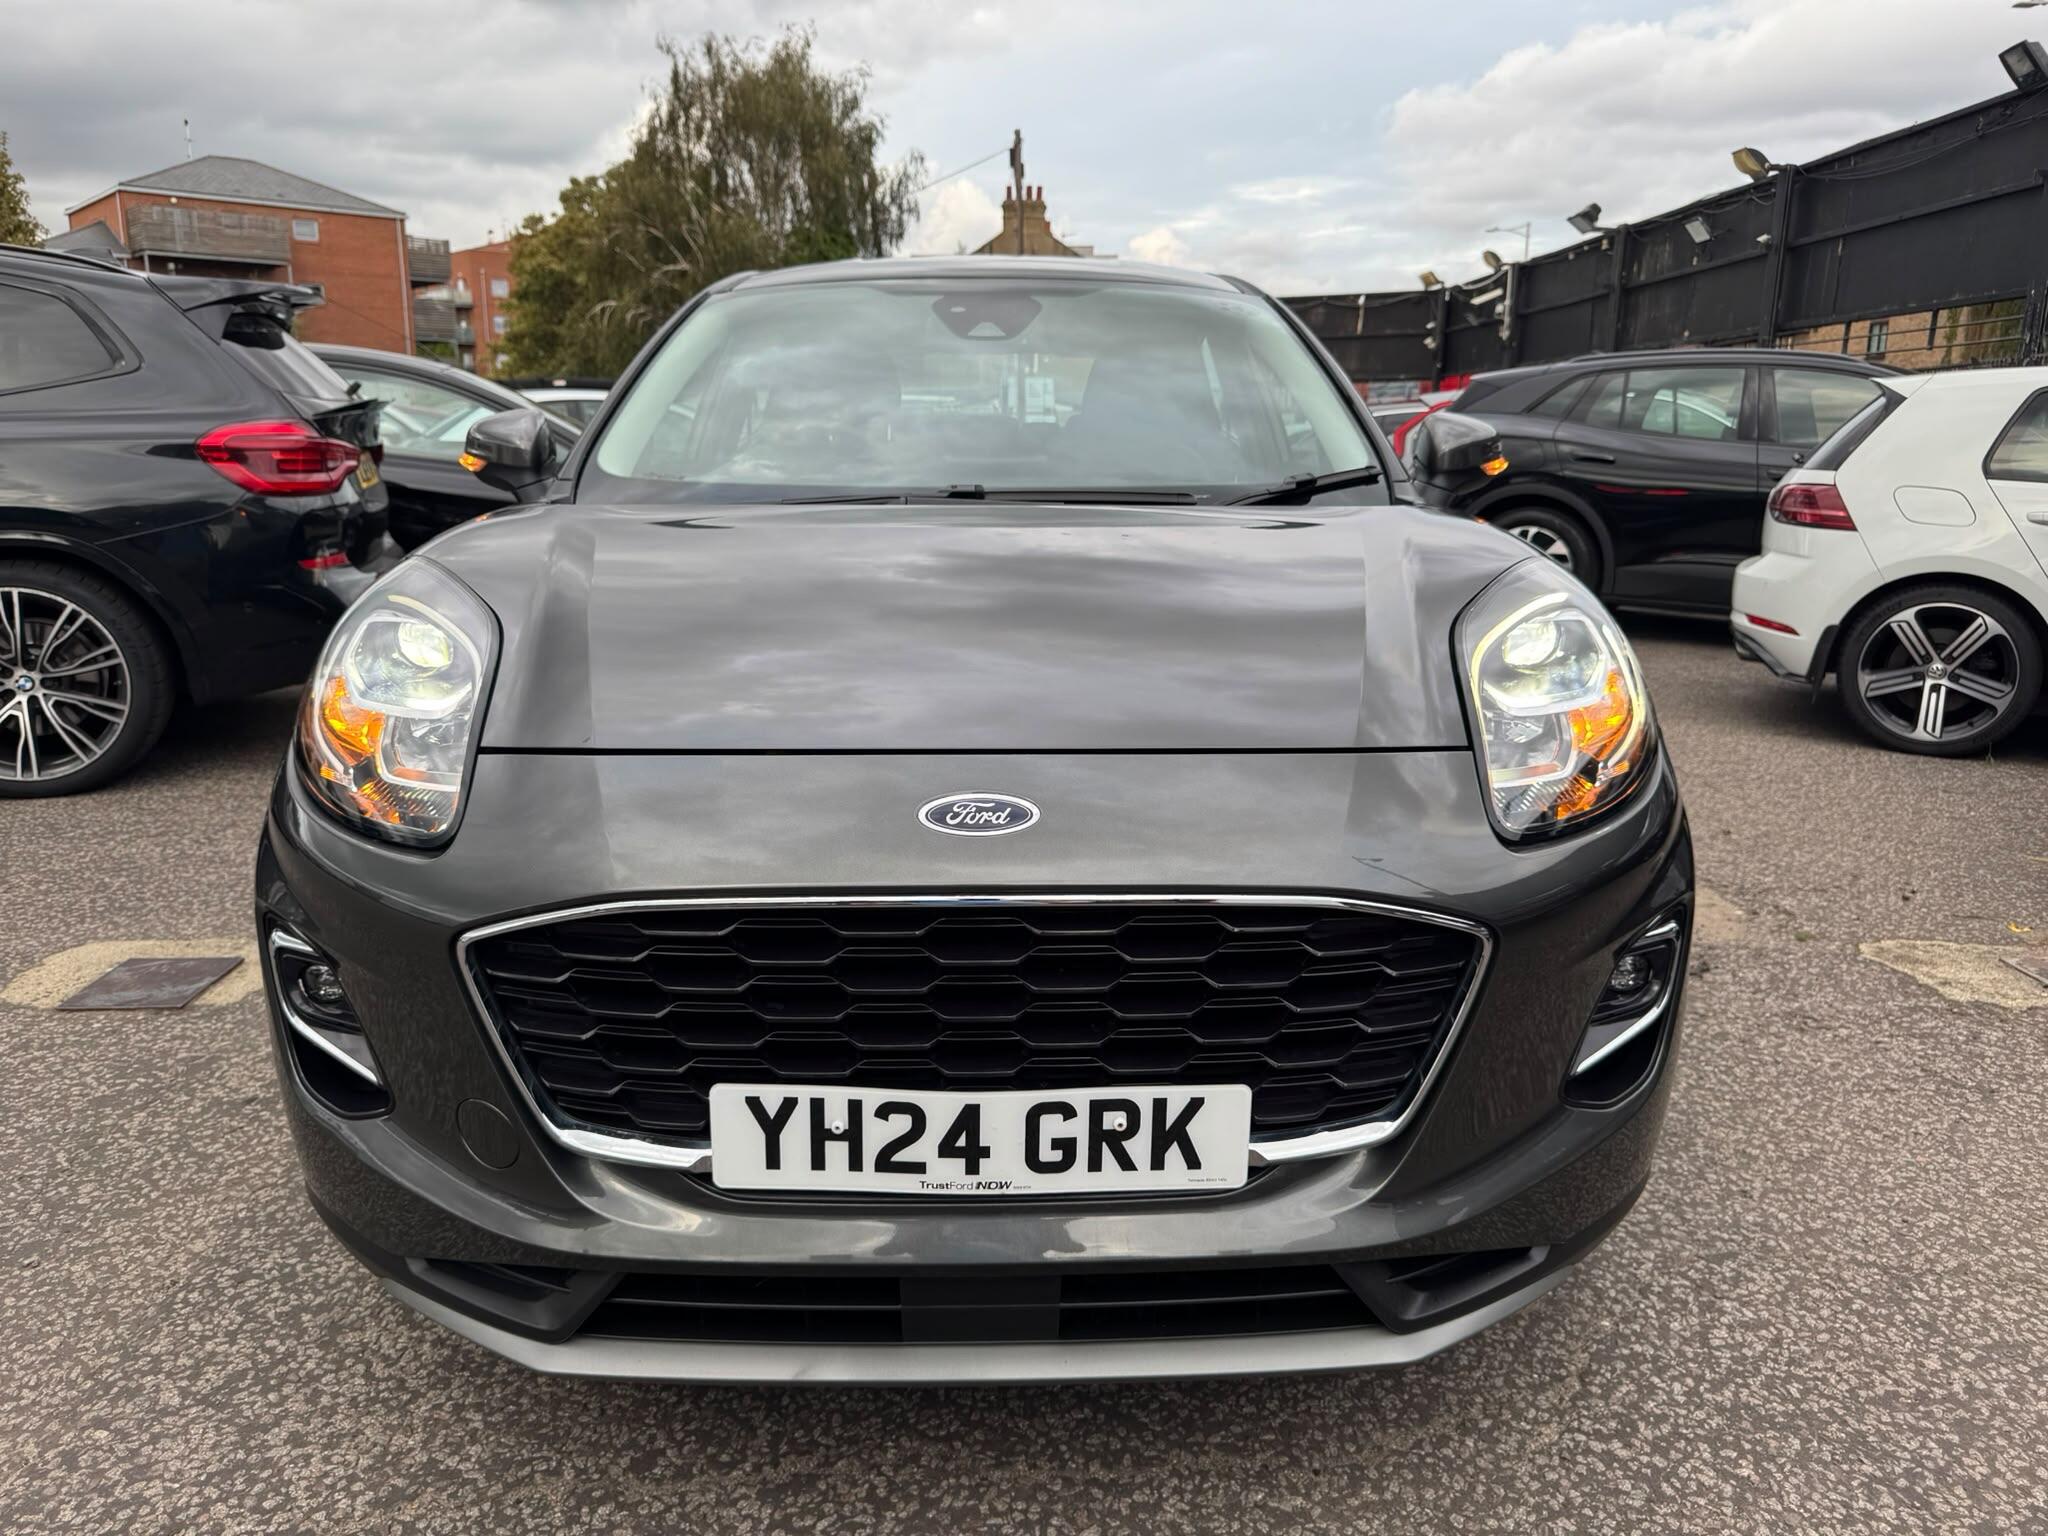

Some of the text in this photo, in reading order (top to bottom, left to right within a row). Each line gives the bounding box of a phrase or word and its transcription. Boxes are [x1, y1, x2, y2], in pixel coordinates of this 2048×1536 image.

[945, 801, 1012, 825] Ford
[745, 1096, 1204, 1175] YH24 GRK
[919, 1181, 973, 1190] TrustFord
[975, 1181, 1013, 1190] NOW
